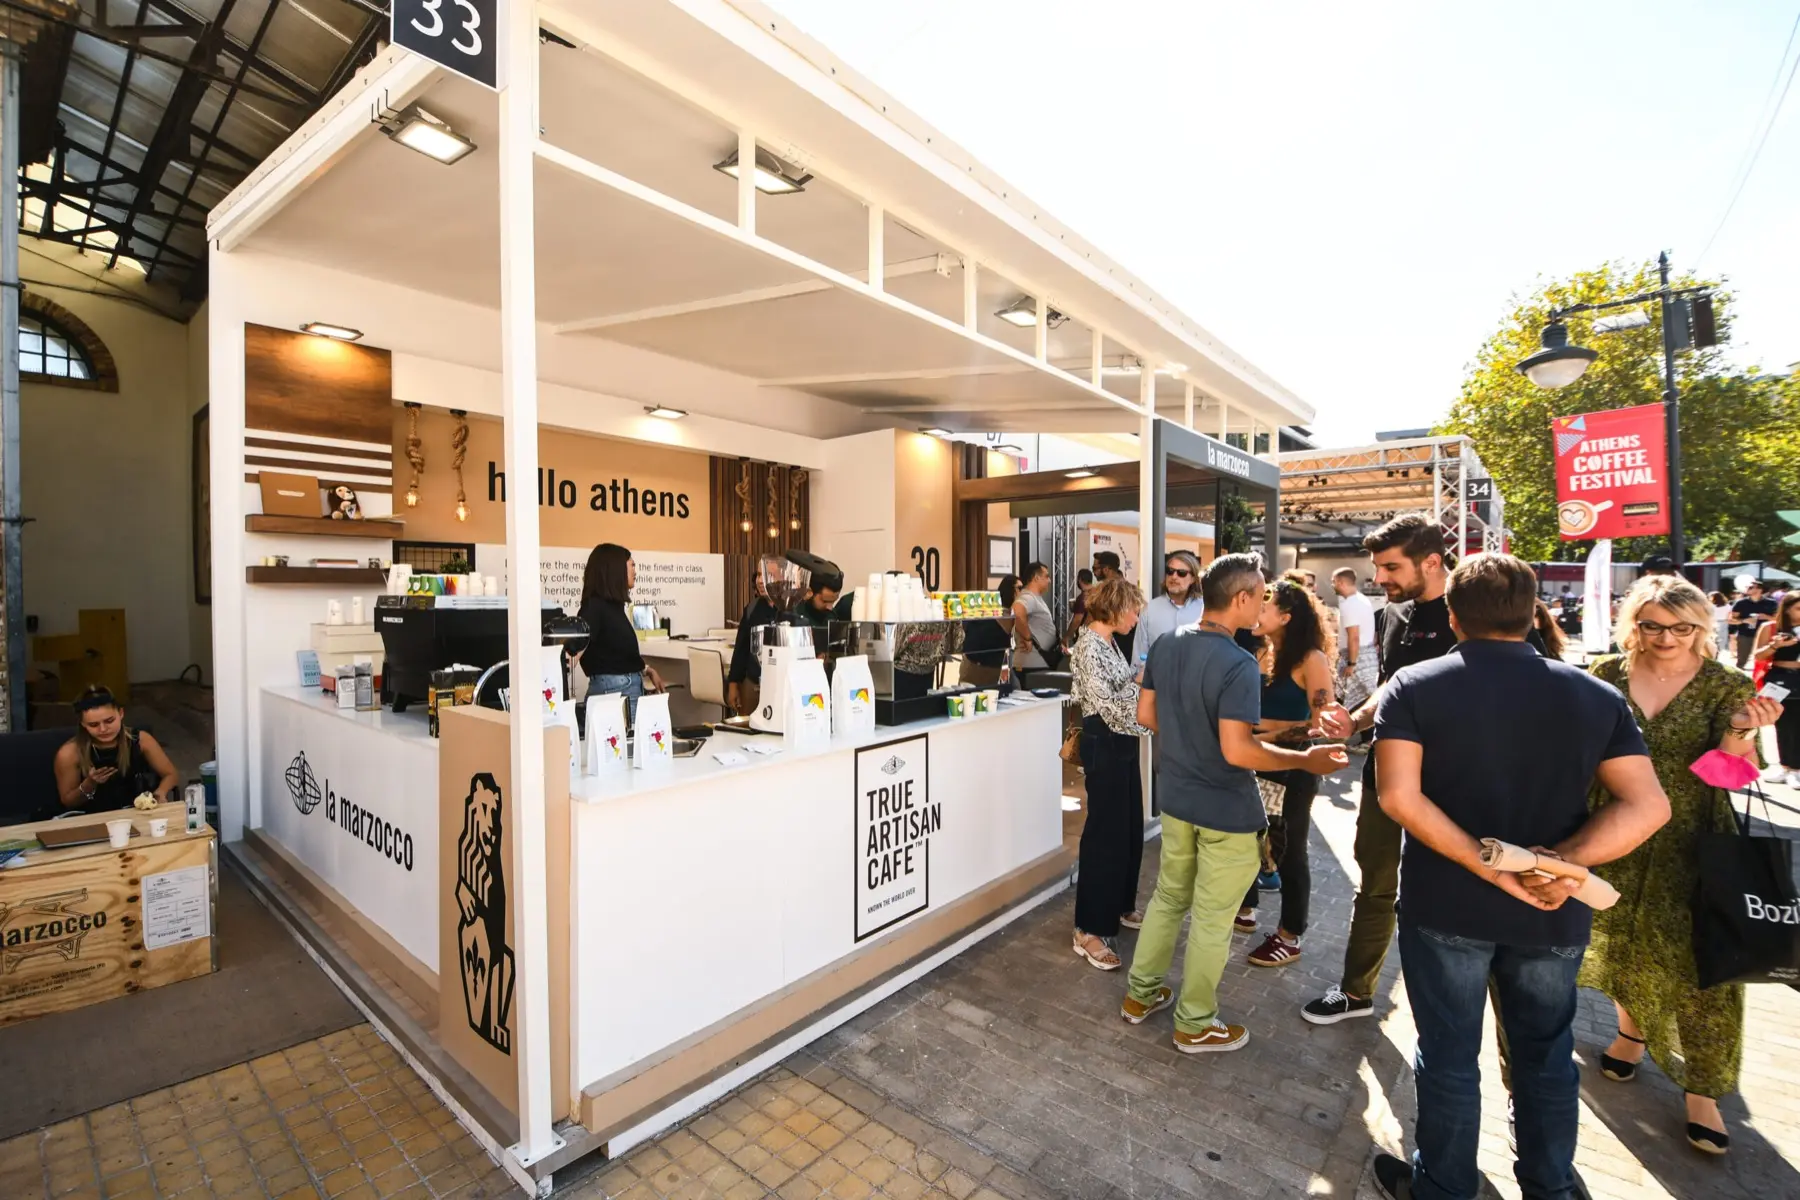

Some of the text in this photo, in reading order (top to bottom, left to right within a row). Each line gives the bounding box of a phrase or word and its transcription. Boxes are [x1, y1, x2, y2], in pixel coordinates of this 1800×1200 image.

[410, 0, 483, 56] 33
[1579, 434, 1641, 454] ATHENS
[1207, 441, 1250, 478] la marzocco
[1573, 449, 1649, 473] COFFEE
[488, 461, 690, 519] hllo athens
[1468, 482, 1489, 497] 34
[1569, 467, 1657, 492] FESTIVAL
[551, 573, 579, 583] coffee
[655, 576, 706, 586] encompassing
[554, 560, 570, 570] the
[638, 563, 651, 572] the
[653, 563, 674, 573] finest
[676, 565, 684, 573] in
[685, 564, 704, 573] class
[911, 545, 940, 592] 30
[544, 586, 661, 597] heritage design
[562, 598, 572, 608] of
[866, 779, 914, 822] TRUE
[325, 778, 414, 872] la marzocco
[866, 802, 941, 858] ARTISAN
[867, 886, 916, 914] KNOWN THE WORLD OVER
[1743, 893, 1800, 925] Bozi
[0, 911, 107, 949] arzocco
